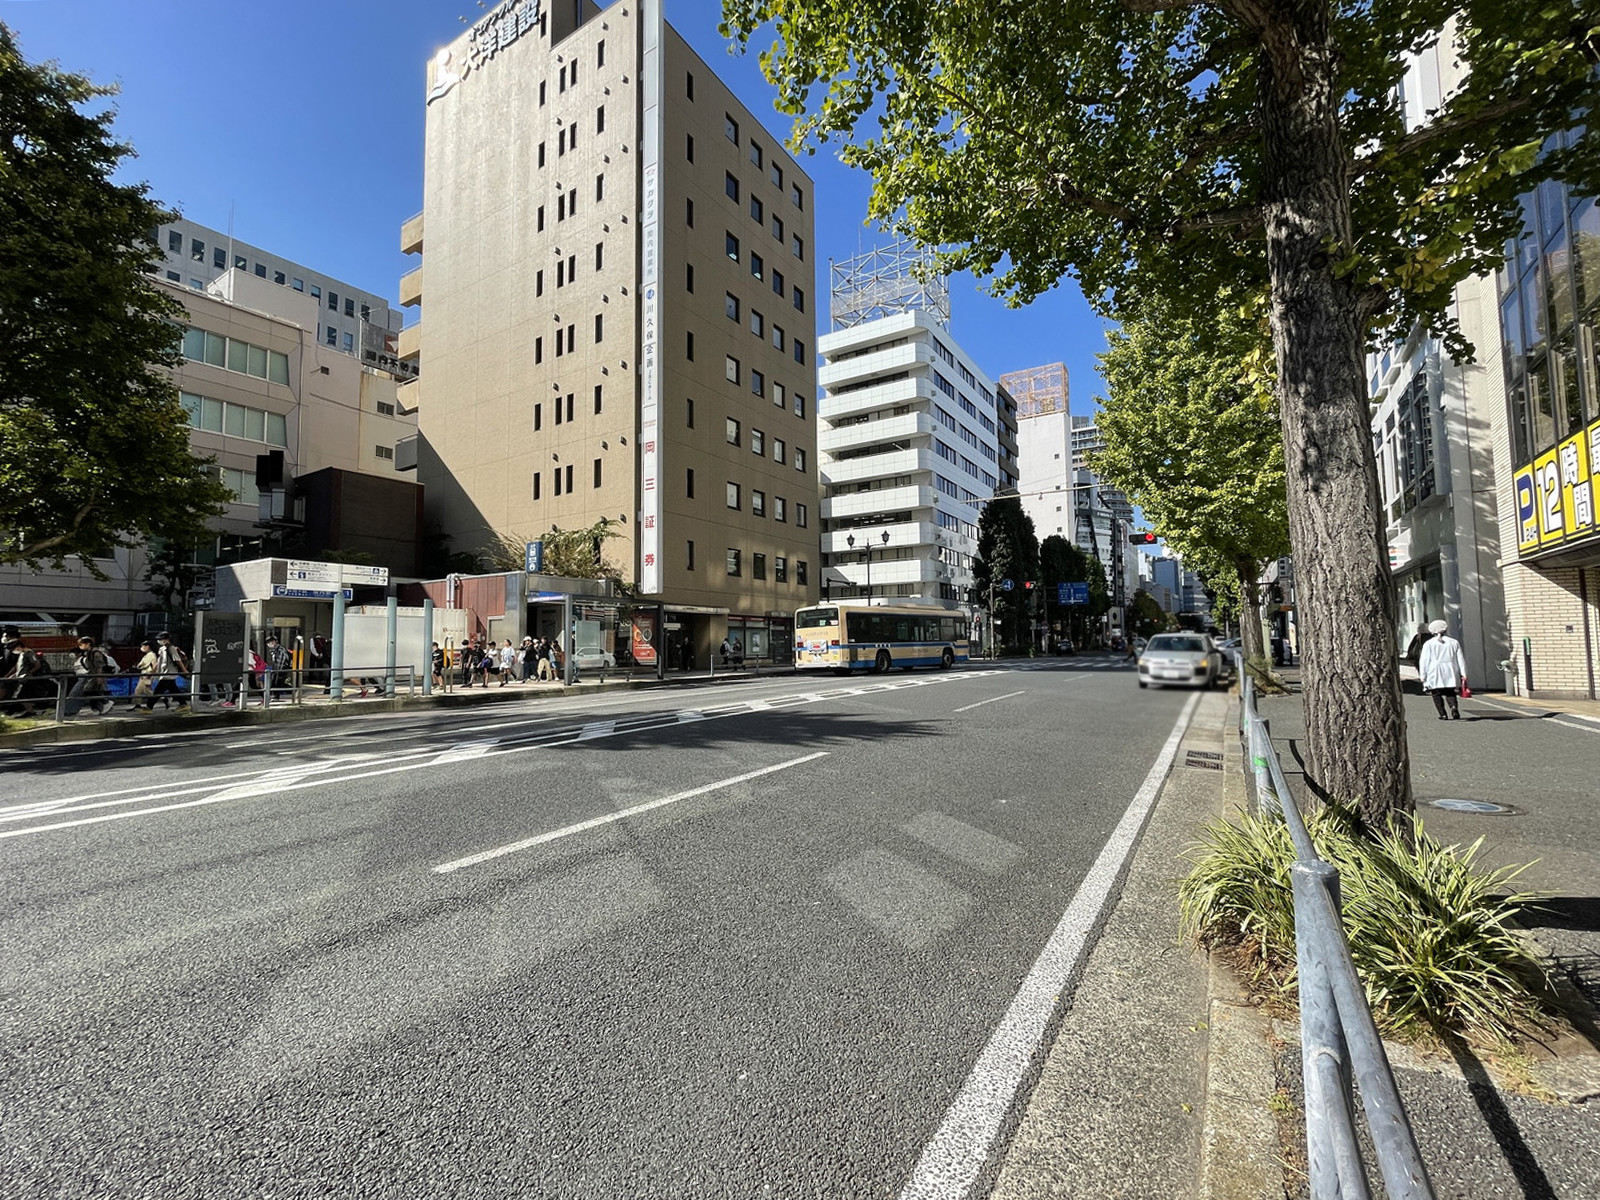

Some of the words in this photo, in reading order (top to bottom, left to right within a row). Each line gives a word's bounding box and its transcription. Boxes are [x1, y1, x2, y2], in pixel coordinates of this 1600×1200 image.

[459, 0, 541, 80] 大洋建設
[645, 441, 655, 567] 岡三証券
[1517, 474, 1534, 542] P
